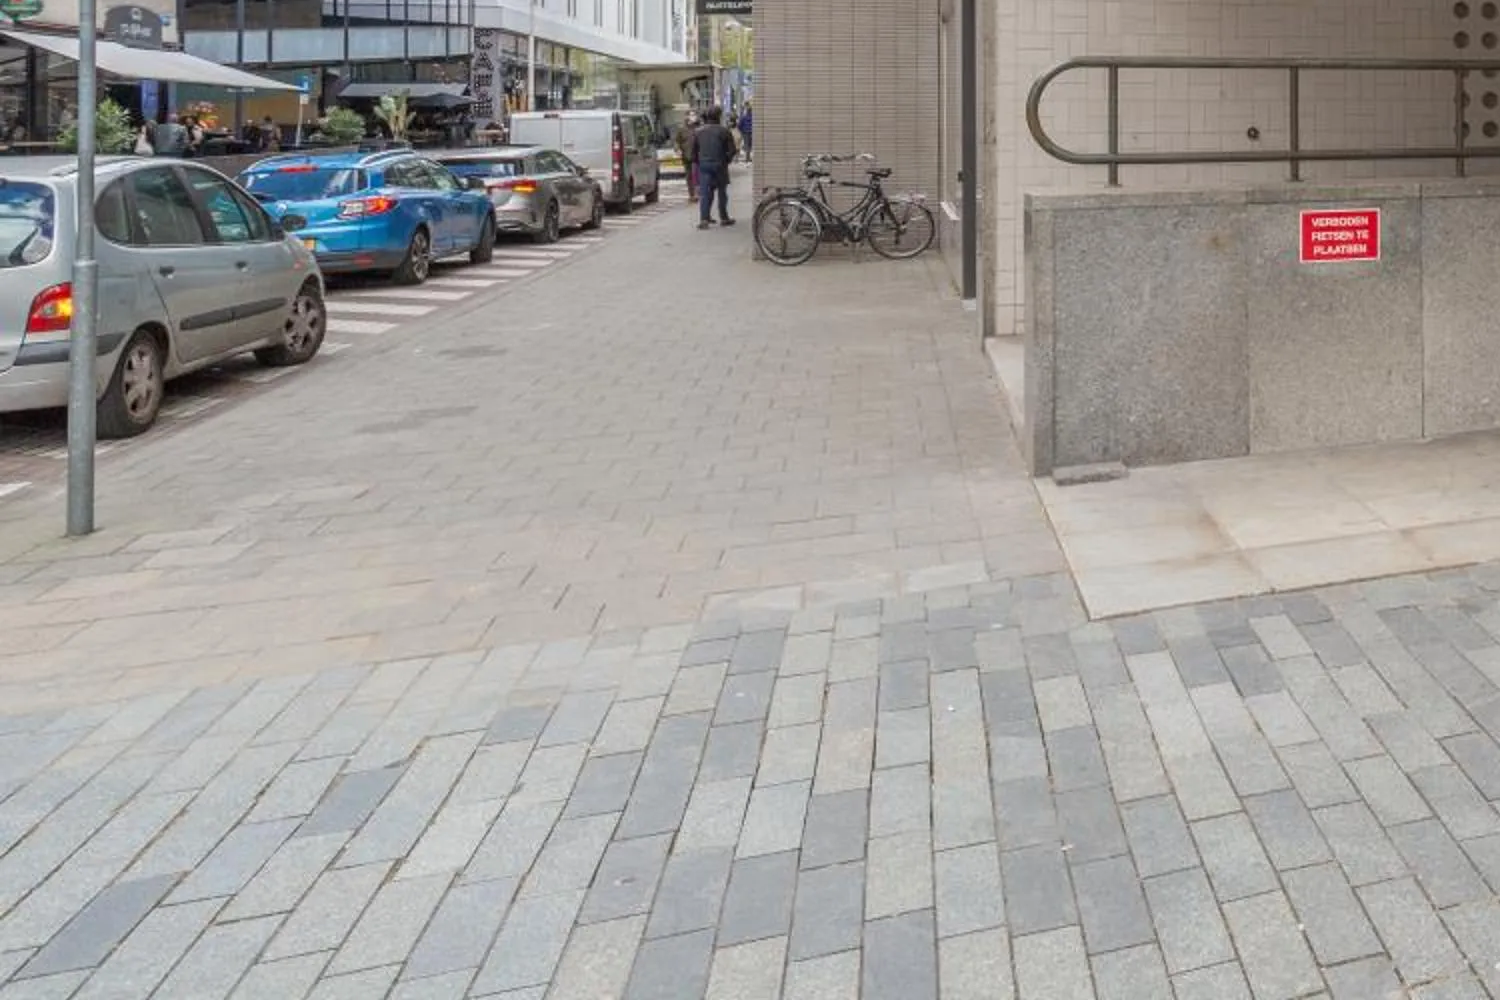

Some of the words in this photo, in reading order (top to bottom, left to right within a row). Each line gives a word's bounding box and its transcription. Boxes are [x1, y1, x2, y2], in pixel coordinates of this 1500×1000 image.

[1311, 215, 1369, 227] VERBODEN
[1311, 231, 1354, 242] FIETSEN
[1355, 229, 1370, 240] TE
[1313, 243, 1367, 256] PLAATSEN
